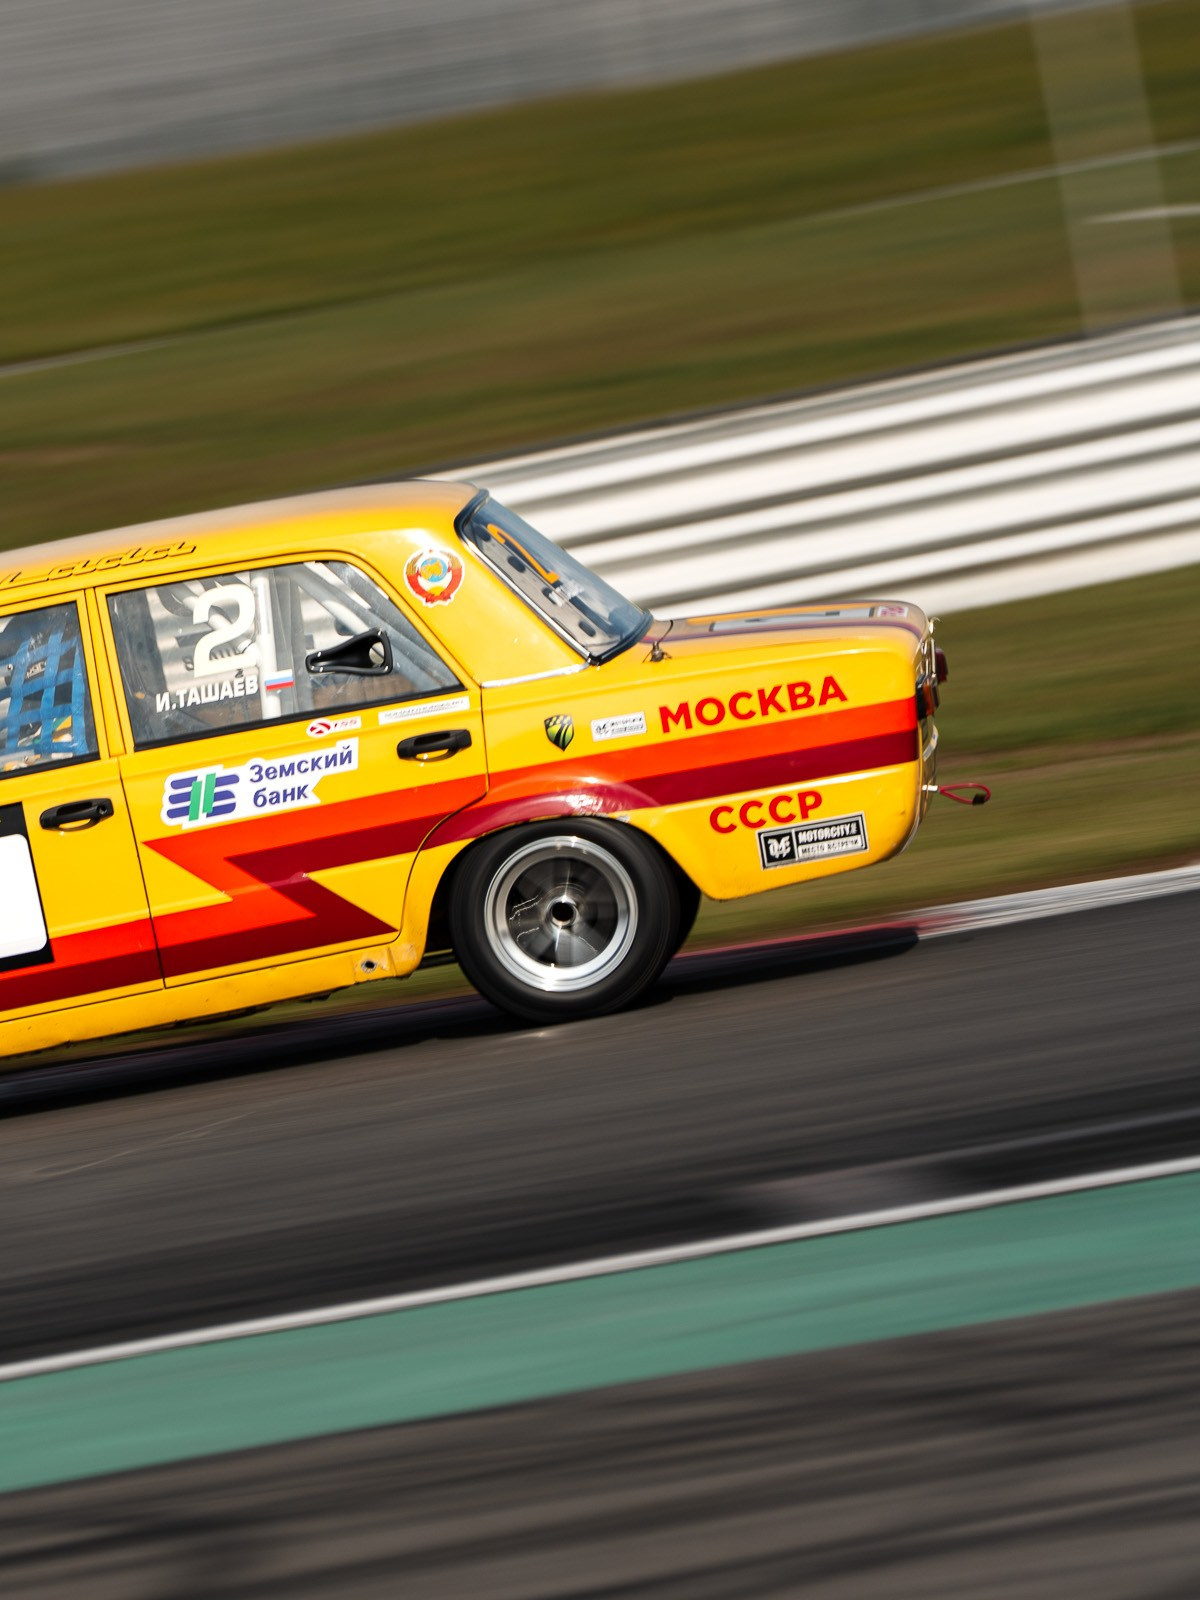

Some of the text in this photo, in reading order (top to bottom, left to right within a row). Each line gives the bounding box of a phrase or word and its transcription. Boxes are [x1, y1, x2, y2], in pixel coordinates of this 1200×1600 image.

[193, 583, 256, 678] 2
[659, 675, 848, 734] МОСКВА
[249, 745, 353, 783] Земский
[253, 784, 309, 808] банк
[709, 790, 823, 834] СССР
